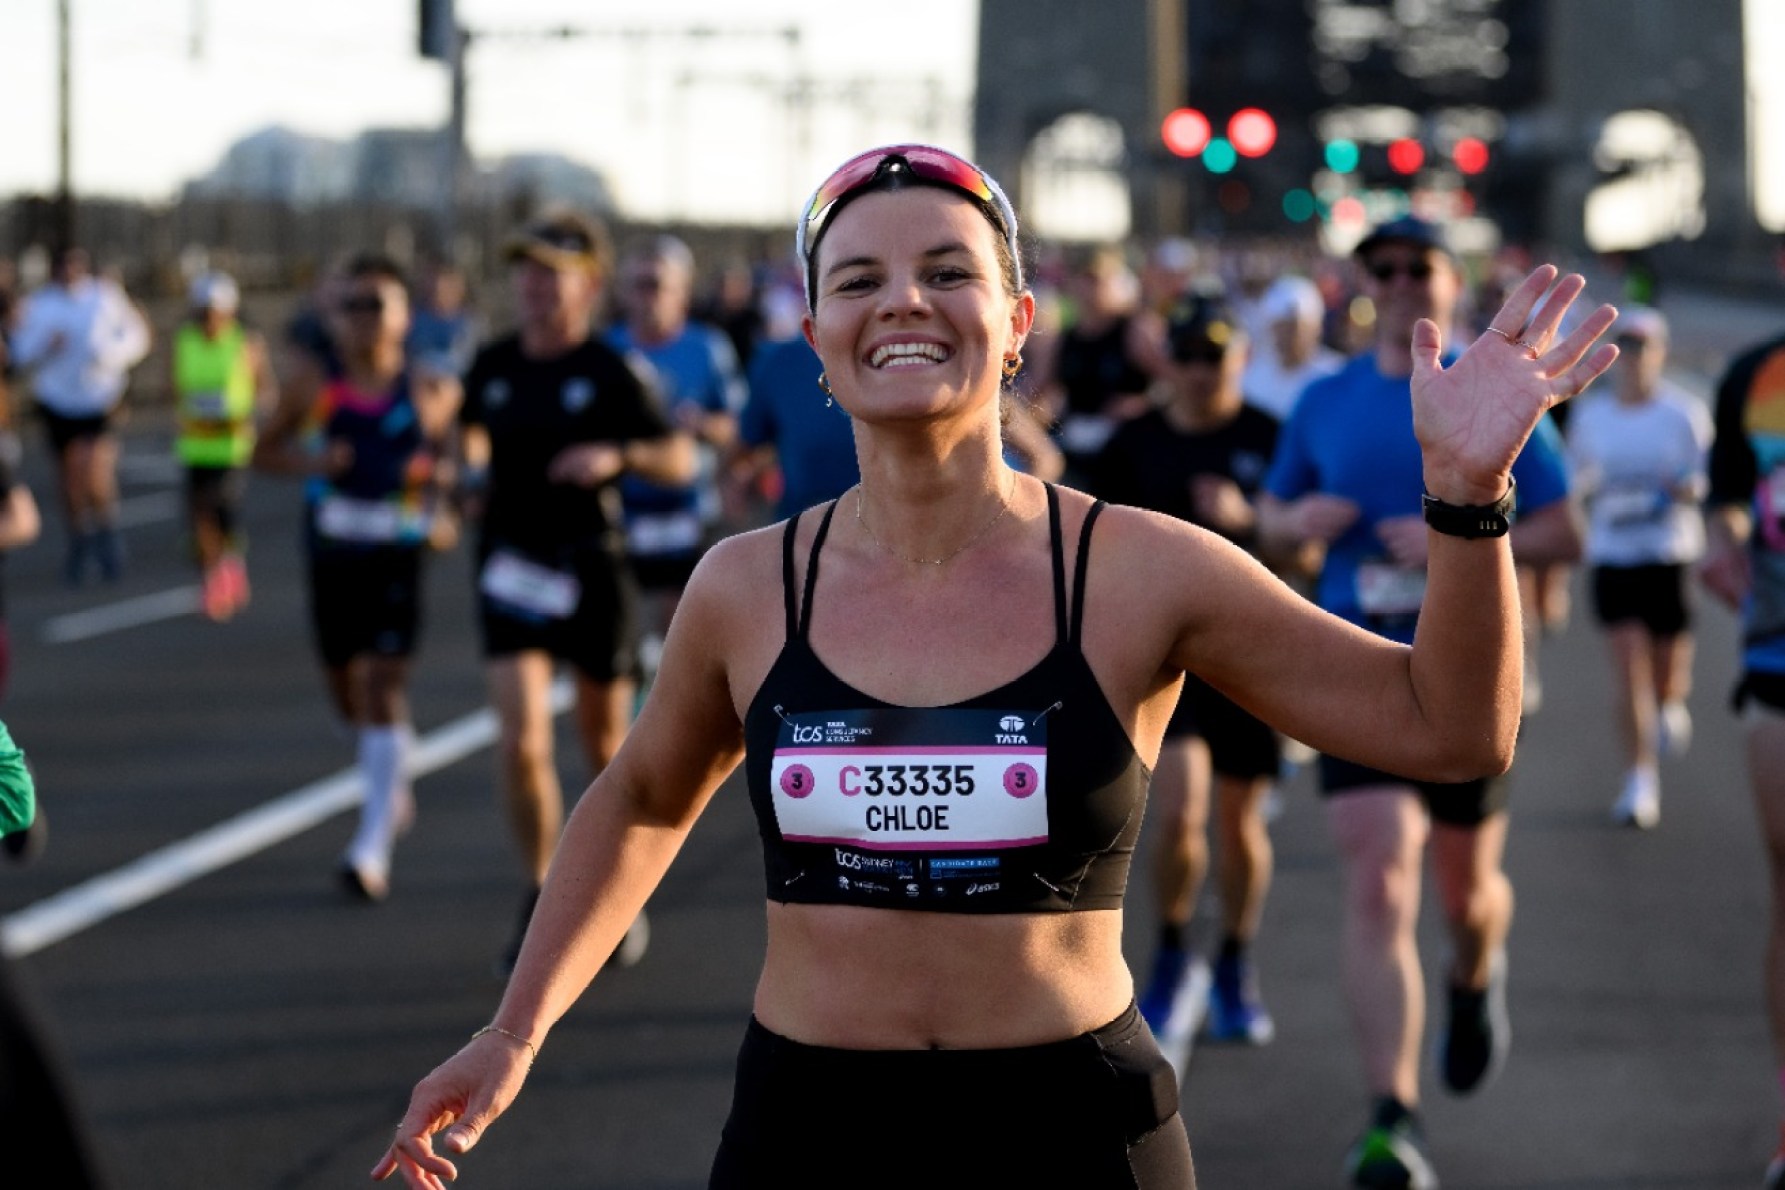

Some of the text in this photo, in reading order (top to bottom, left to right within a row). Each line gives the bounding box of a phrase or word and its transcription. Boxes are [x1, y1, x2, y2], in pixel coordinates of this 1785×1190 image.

[793, 722, 823, 744] tcs
[995, 733, 1029, 745] TATA
[790, 772, 803, 790] 3
[838, 765, 975, 796] C33335
[1014, 771, 1027, 789] 3
[865, 804, 950, 831] CHLOE
[834, 847, 861, 870] tcs
